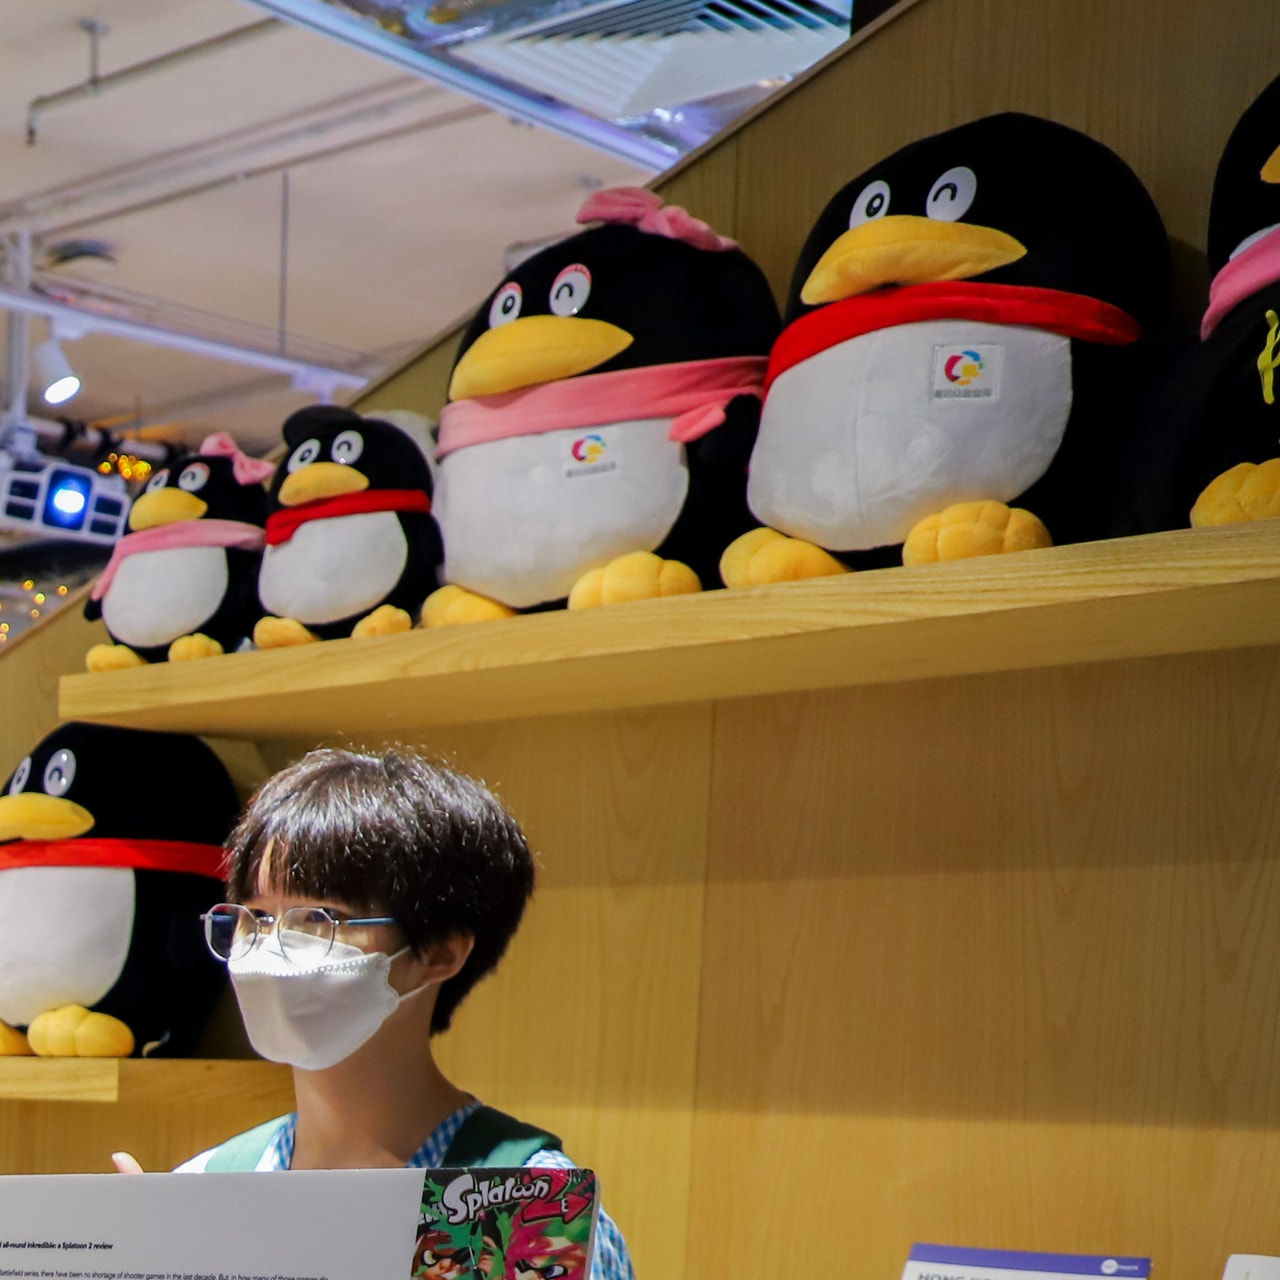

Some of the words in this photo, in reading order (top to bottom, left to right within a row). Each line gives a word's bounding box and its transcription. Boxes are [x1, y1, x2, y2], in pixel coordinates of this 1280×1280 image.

[442, 1173, 549, 1225] Splatoon
[61, 1241, 87, 1251] Splatoon
[93, 1242, 113, 1250] review
[55, 1270, 68, 1278] have
[91, 1271, 116, 1280] shortage
[116, 1271, 123, 1279] of
[123, 1271, 145, 1279] shooter
[145, 1273, 165, 1280] games
